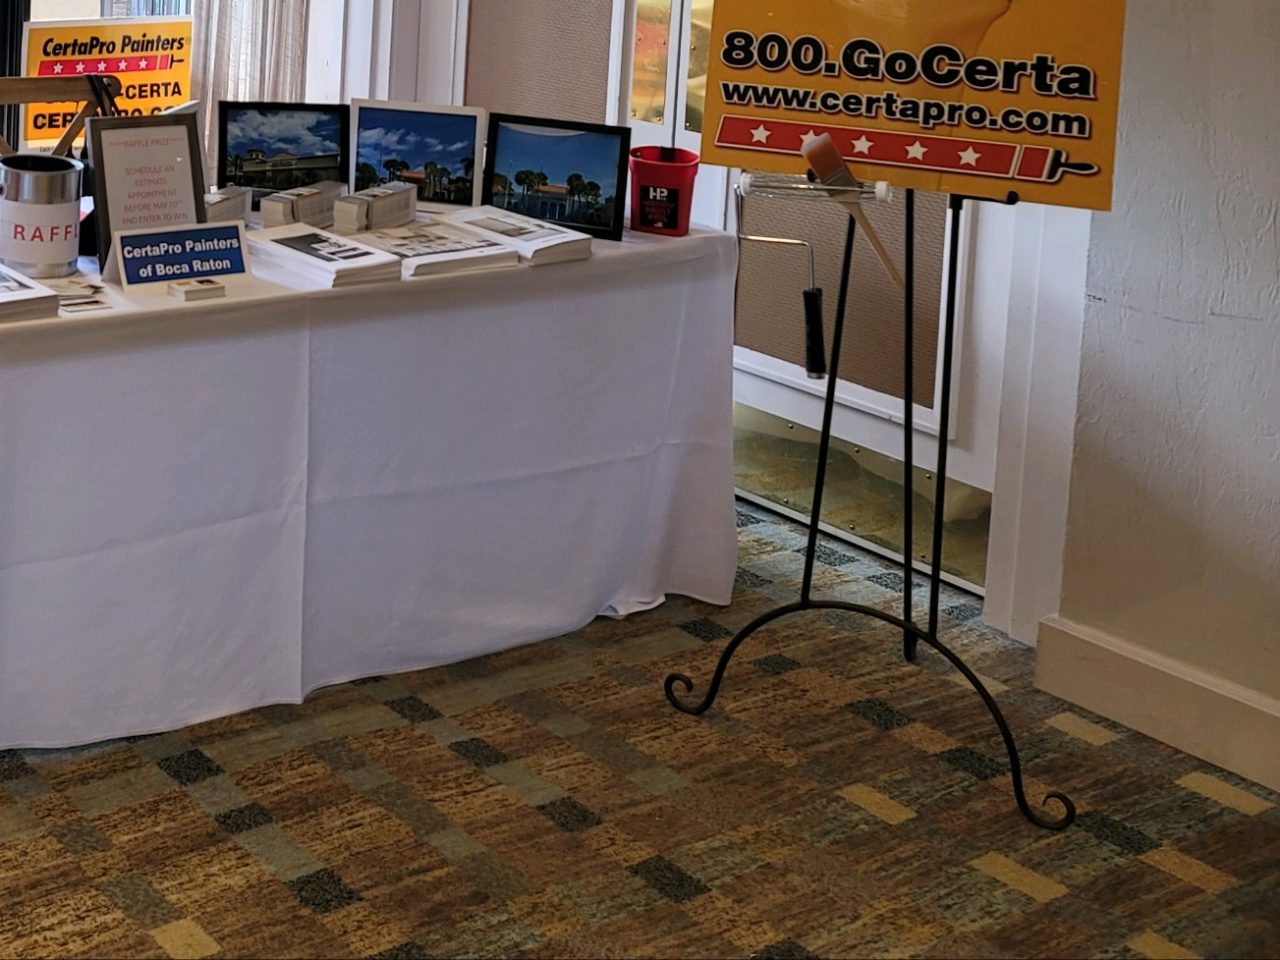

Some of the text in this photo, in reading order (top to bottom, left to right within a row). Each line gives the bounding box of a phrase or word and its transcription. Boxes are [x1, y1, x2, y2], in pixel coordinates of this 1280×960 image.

[42, 33, 185, 57] CertaPro Painters
[719, 29, 1097, 100] 800.GoCerta
[720, 79, 1092, 138] www.certapro.com
[123, 238, 240, 259] CertaPro Painters
[139, 258, 232, 278] of Boca Raton
